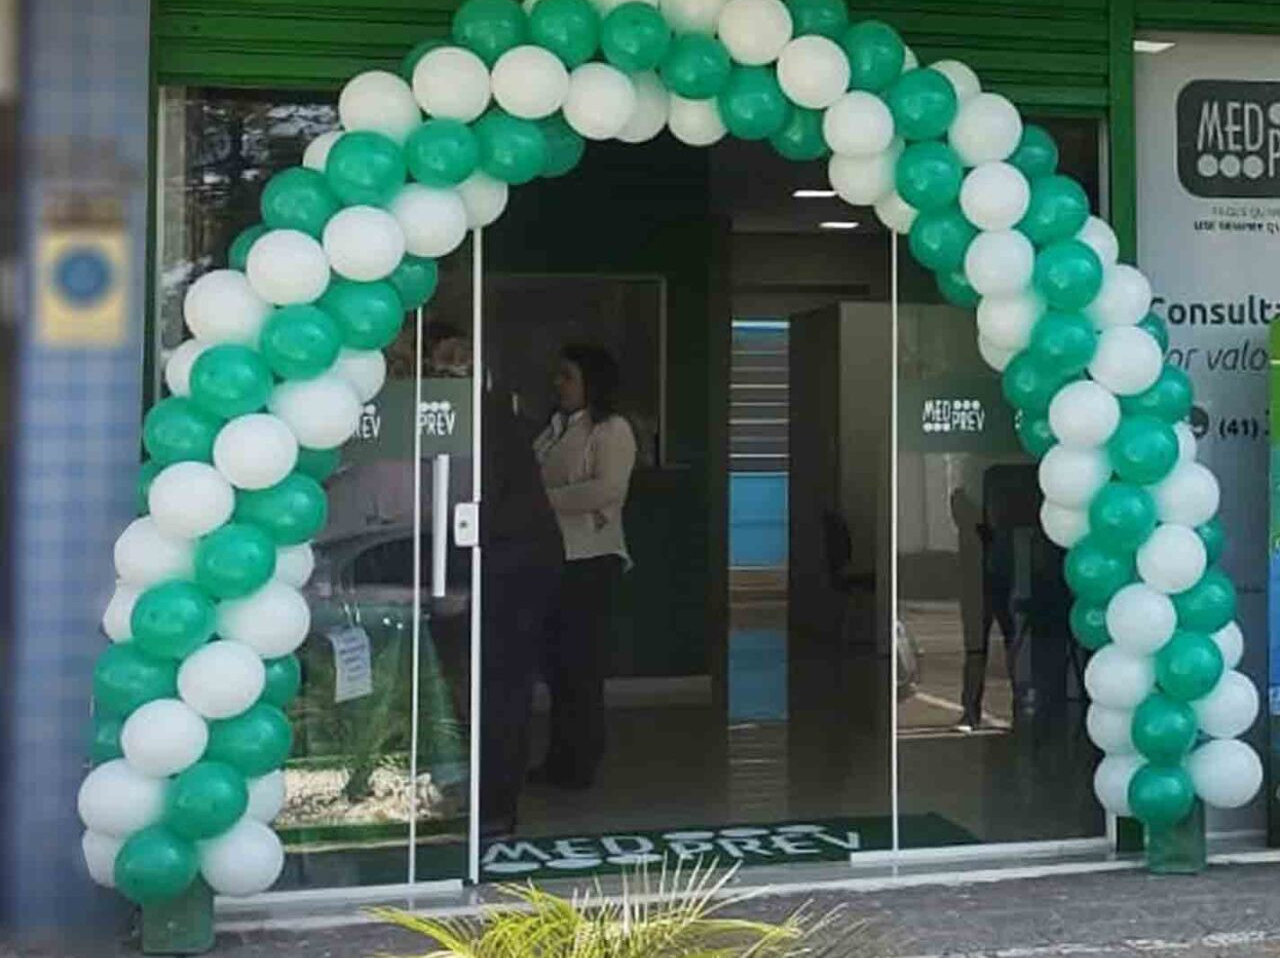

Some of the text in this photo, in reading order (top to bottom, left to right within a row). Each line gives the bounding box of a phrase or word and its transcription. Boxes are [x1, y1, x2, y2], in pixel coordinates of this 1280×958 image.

[1196, 101, 1264, 152] MED
[1165, 348, 1198, 371] or
[1207, 339, 1268, 371] valo
[1219, 419, 1258, 438] (41)
